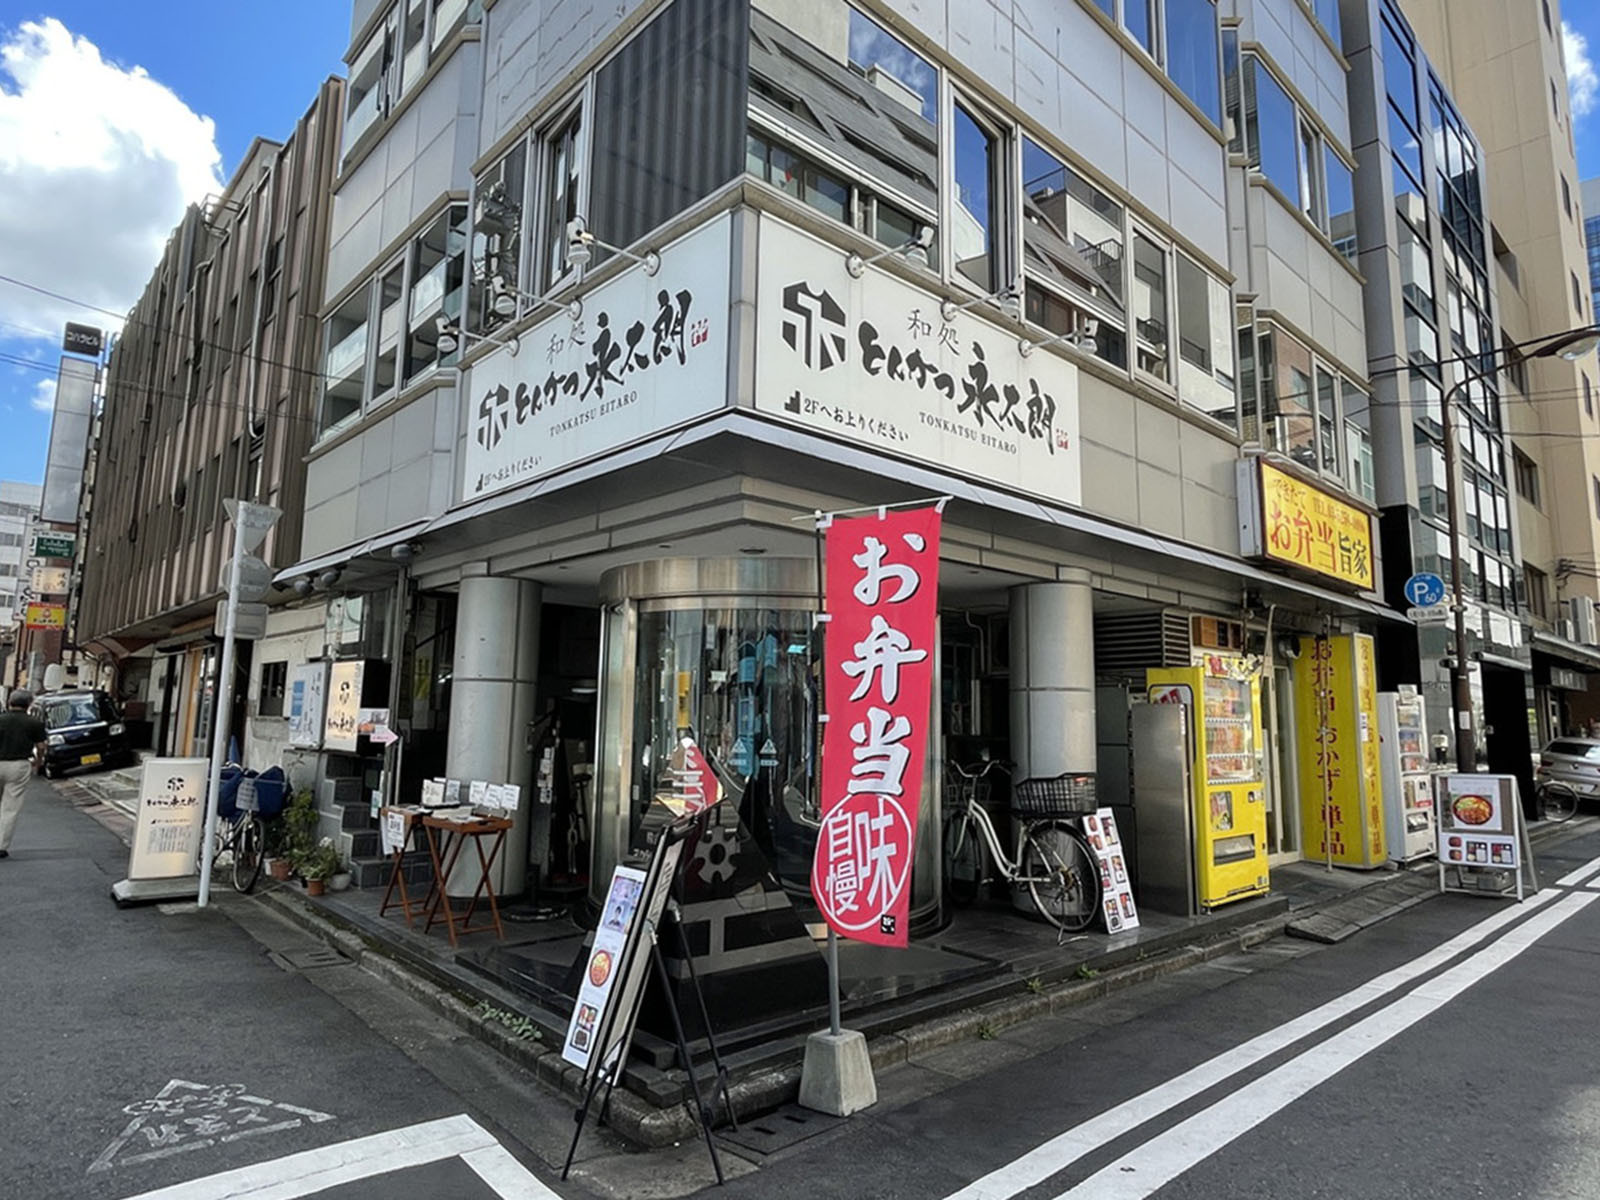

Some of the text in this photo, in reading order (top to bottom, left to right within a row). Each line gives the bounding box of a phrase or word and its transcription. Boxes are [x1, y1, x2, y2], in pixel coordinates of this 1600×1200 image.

[547, 320, 586, 363] 和処
[908, 307, 959, 356] 和処
[550, 390, 638, 438] TONKATSU EITARO
[804, 397, 909, 442] 2Fへお上りください
[919, 411, 1018, 456] TONKATSU EITARO
[1413, 582, 1429, 604] P
[841, 532, 927, 798] お弁当
